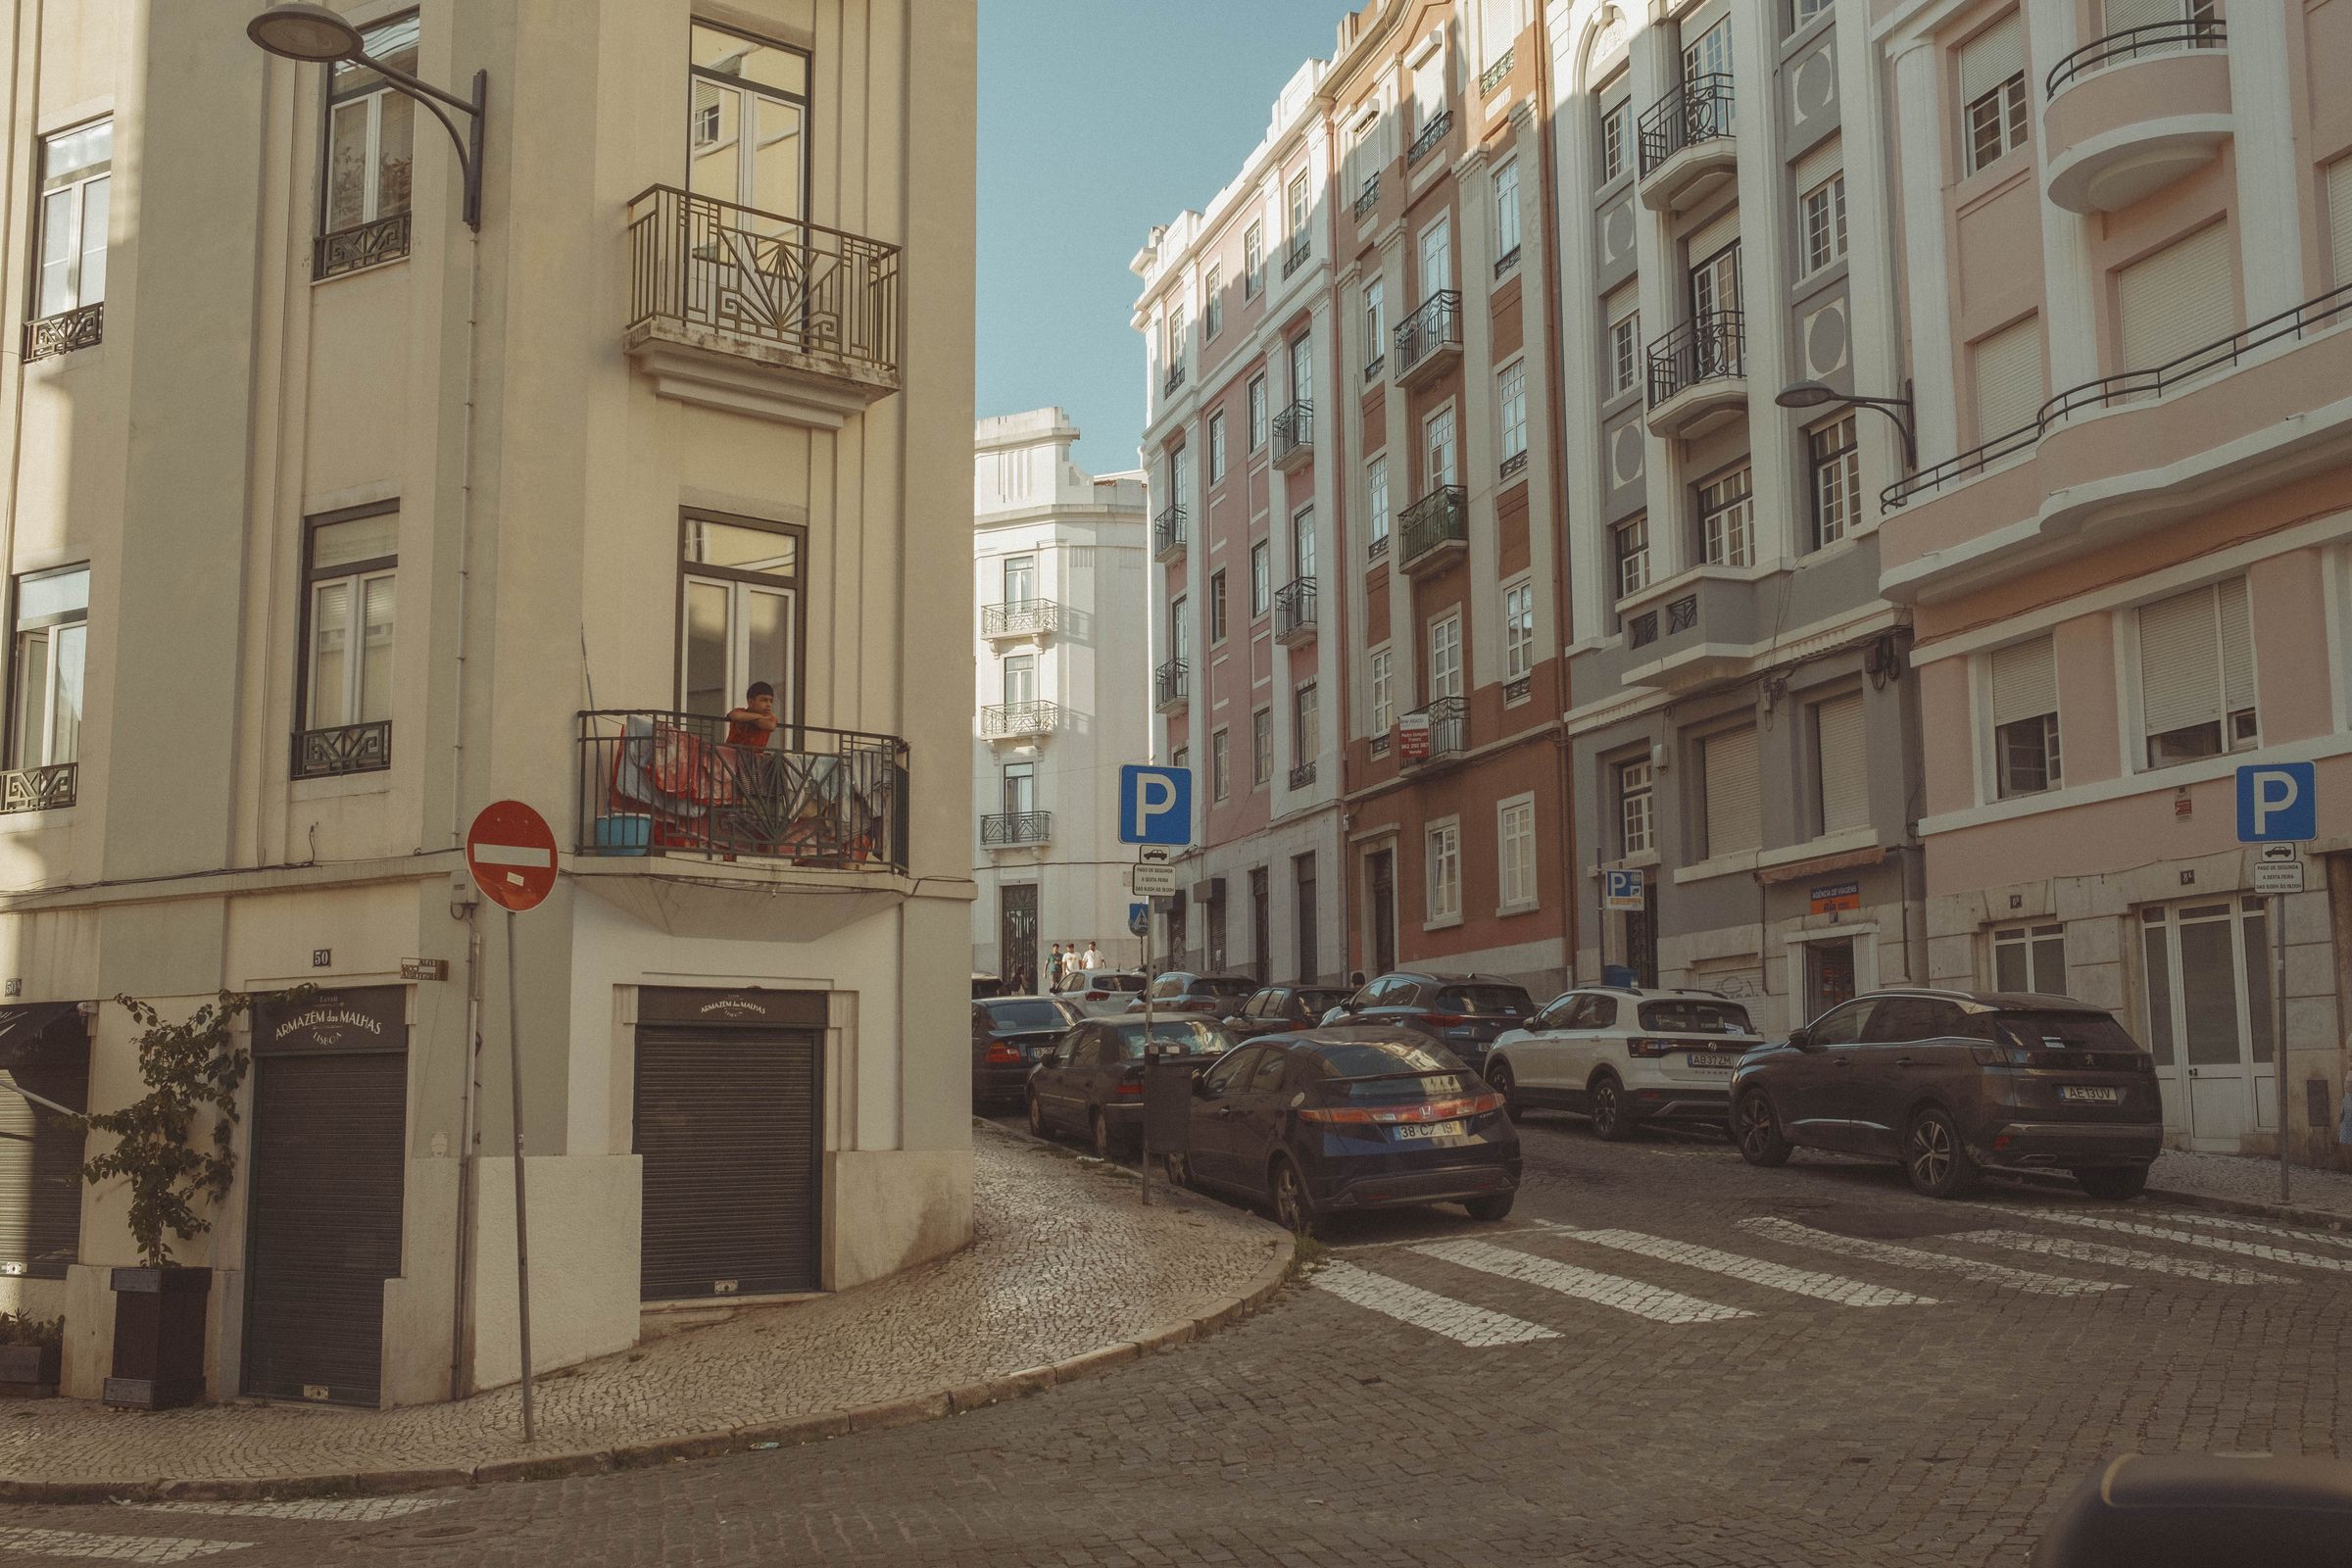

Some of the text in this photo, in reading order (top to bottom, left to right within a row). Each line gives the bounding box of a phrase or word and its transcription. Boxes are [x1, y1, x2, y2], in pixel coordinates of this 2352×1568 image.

[1136, 773, 1176, 836] P
[2254, 771, 2298, 835] P
[1611, 873, 1626, 897] P
[315, 951, 328, 965] 50
[276, 1010, 382, 1040] ARMAZÉM das MALHAS
[313, 1032, 342, 1045] LISBOA
